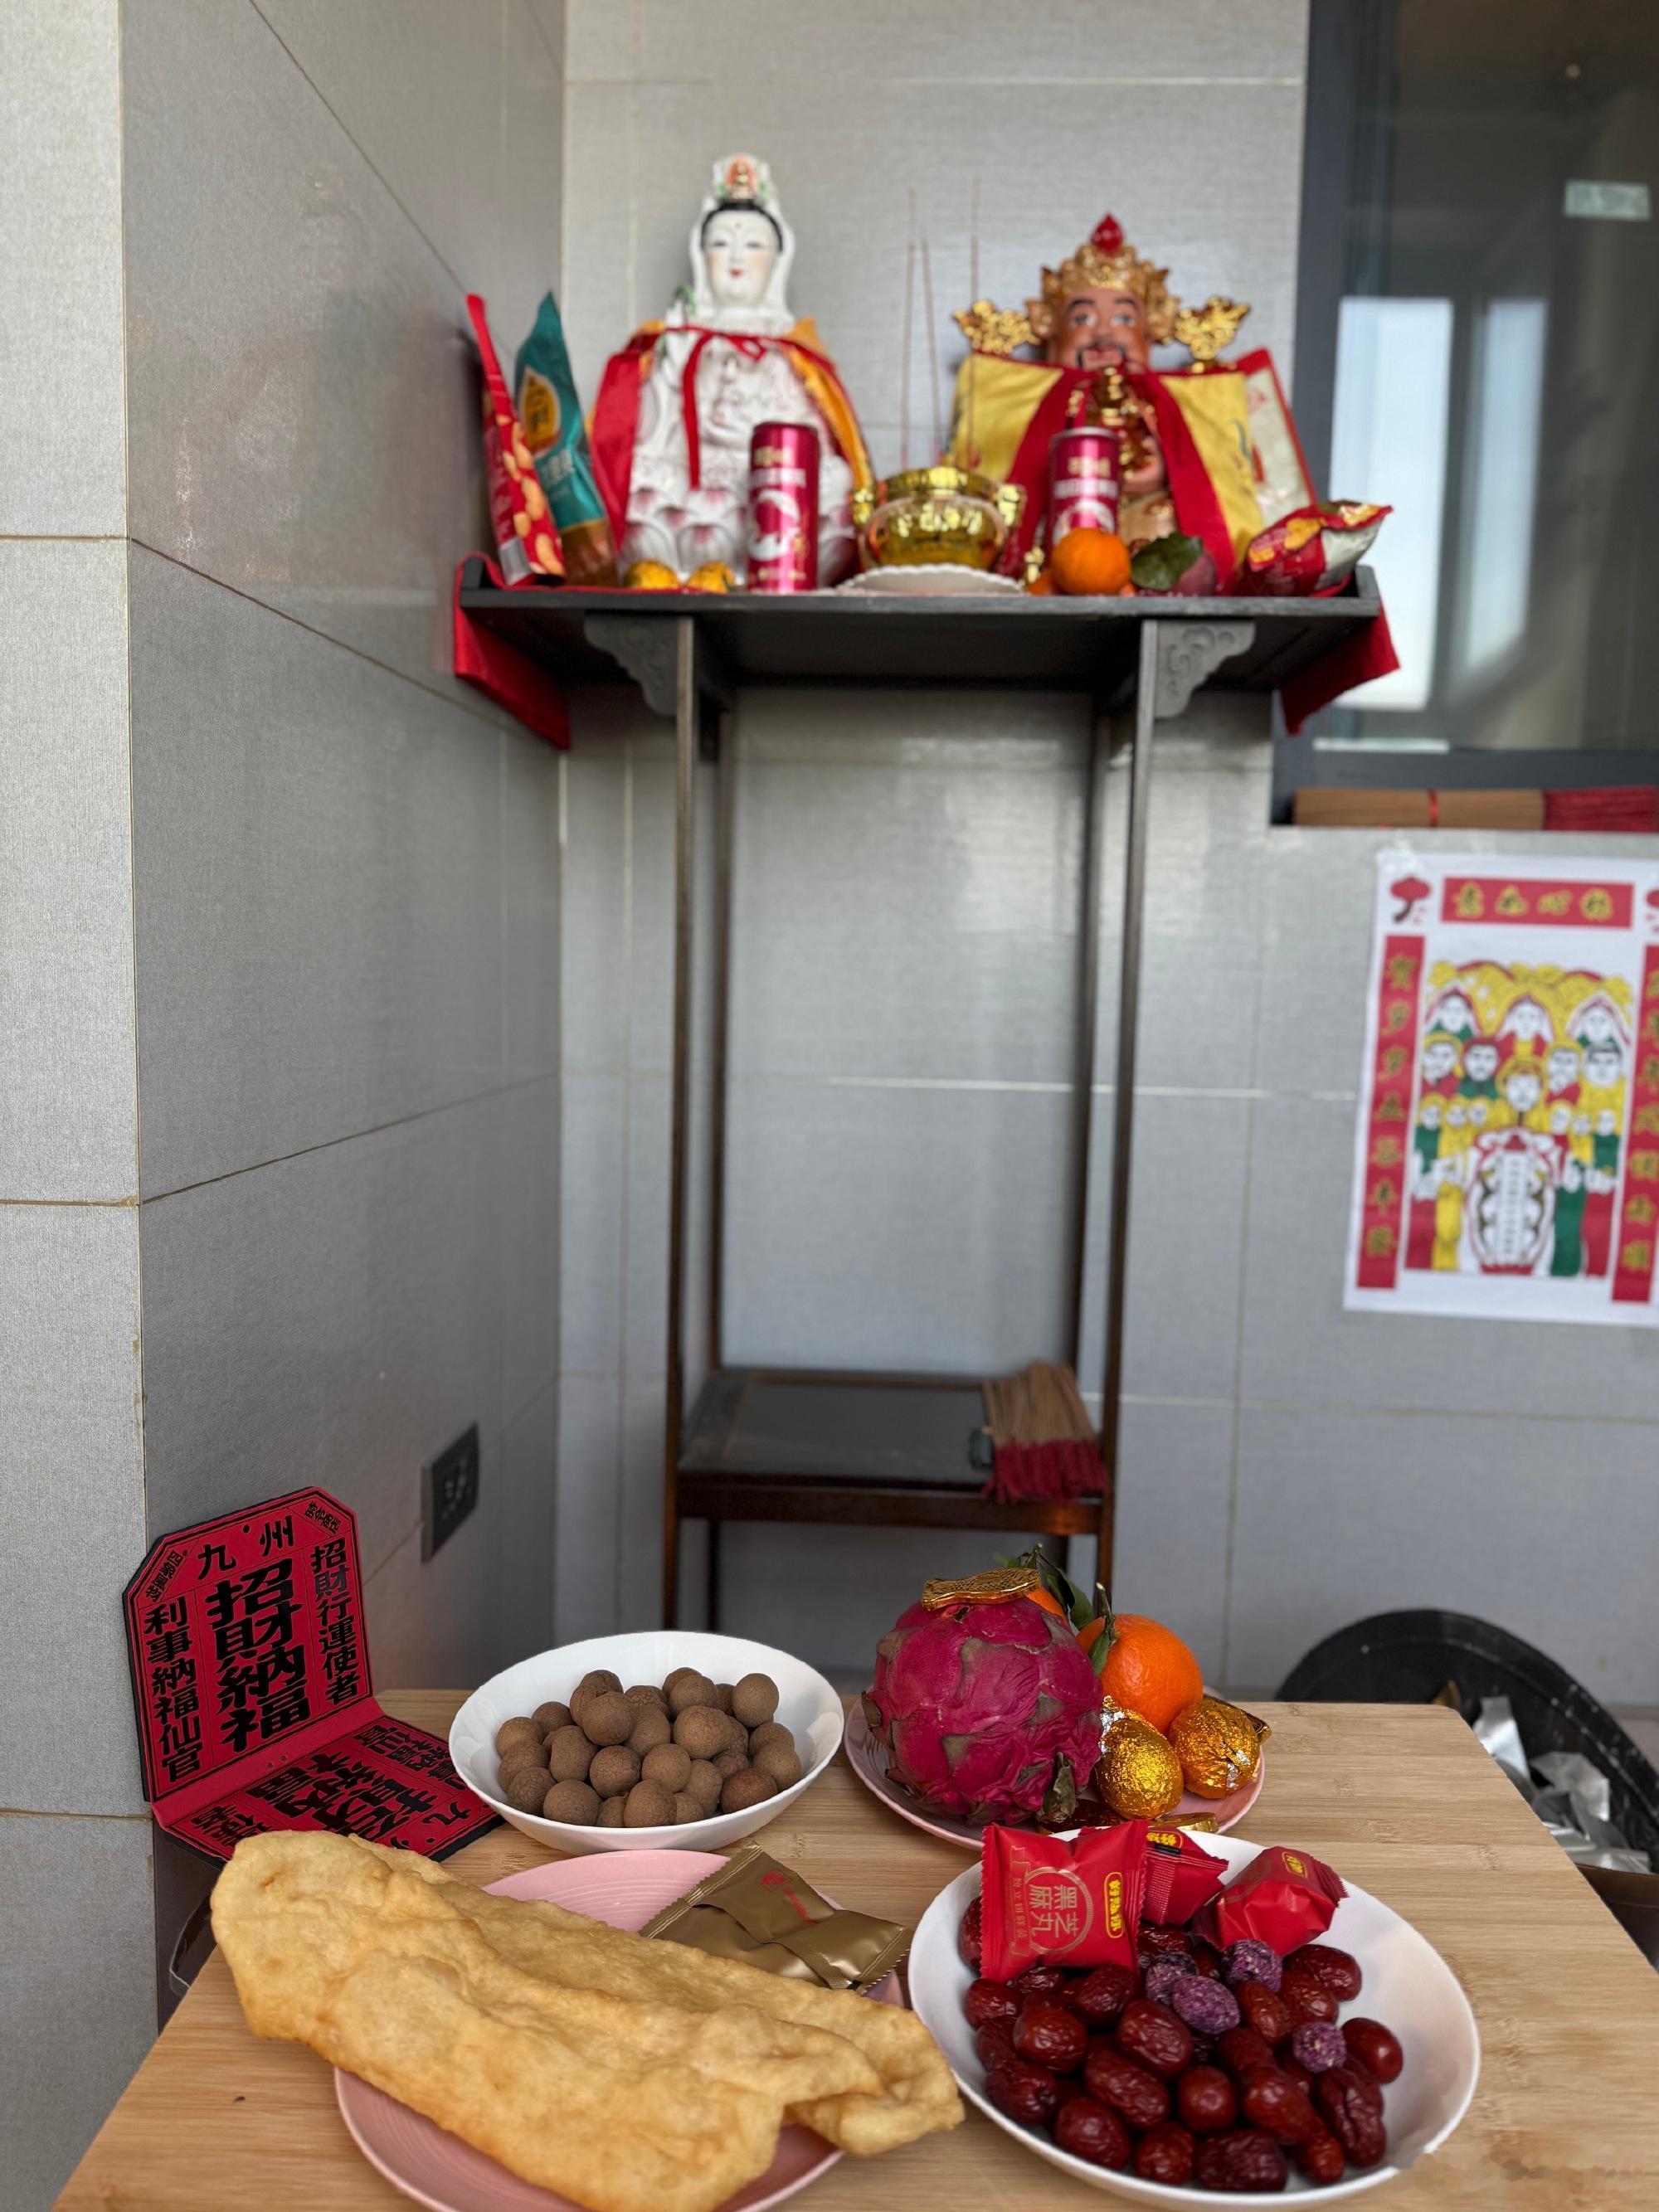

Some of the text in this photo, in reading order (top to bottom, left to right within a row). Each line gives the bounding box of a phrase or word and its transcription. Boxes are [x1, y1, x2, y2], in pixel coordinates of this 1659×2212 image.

[197, 1515, 294, 1581] 九州
[310, 1537, 361, 1705] 招財行運使者
[144, 1596, 202, 1782] 利事納福仙官
[205, 1558, 310, 1753] 招財納福
